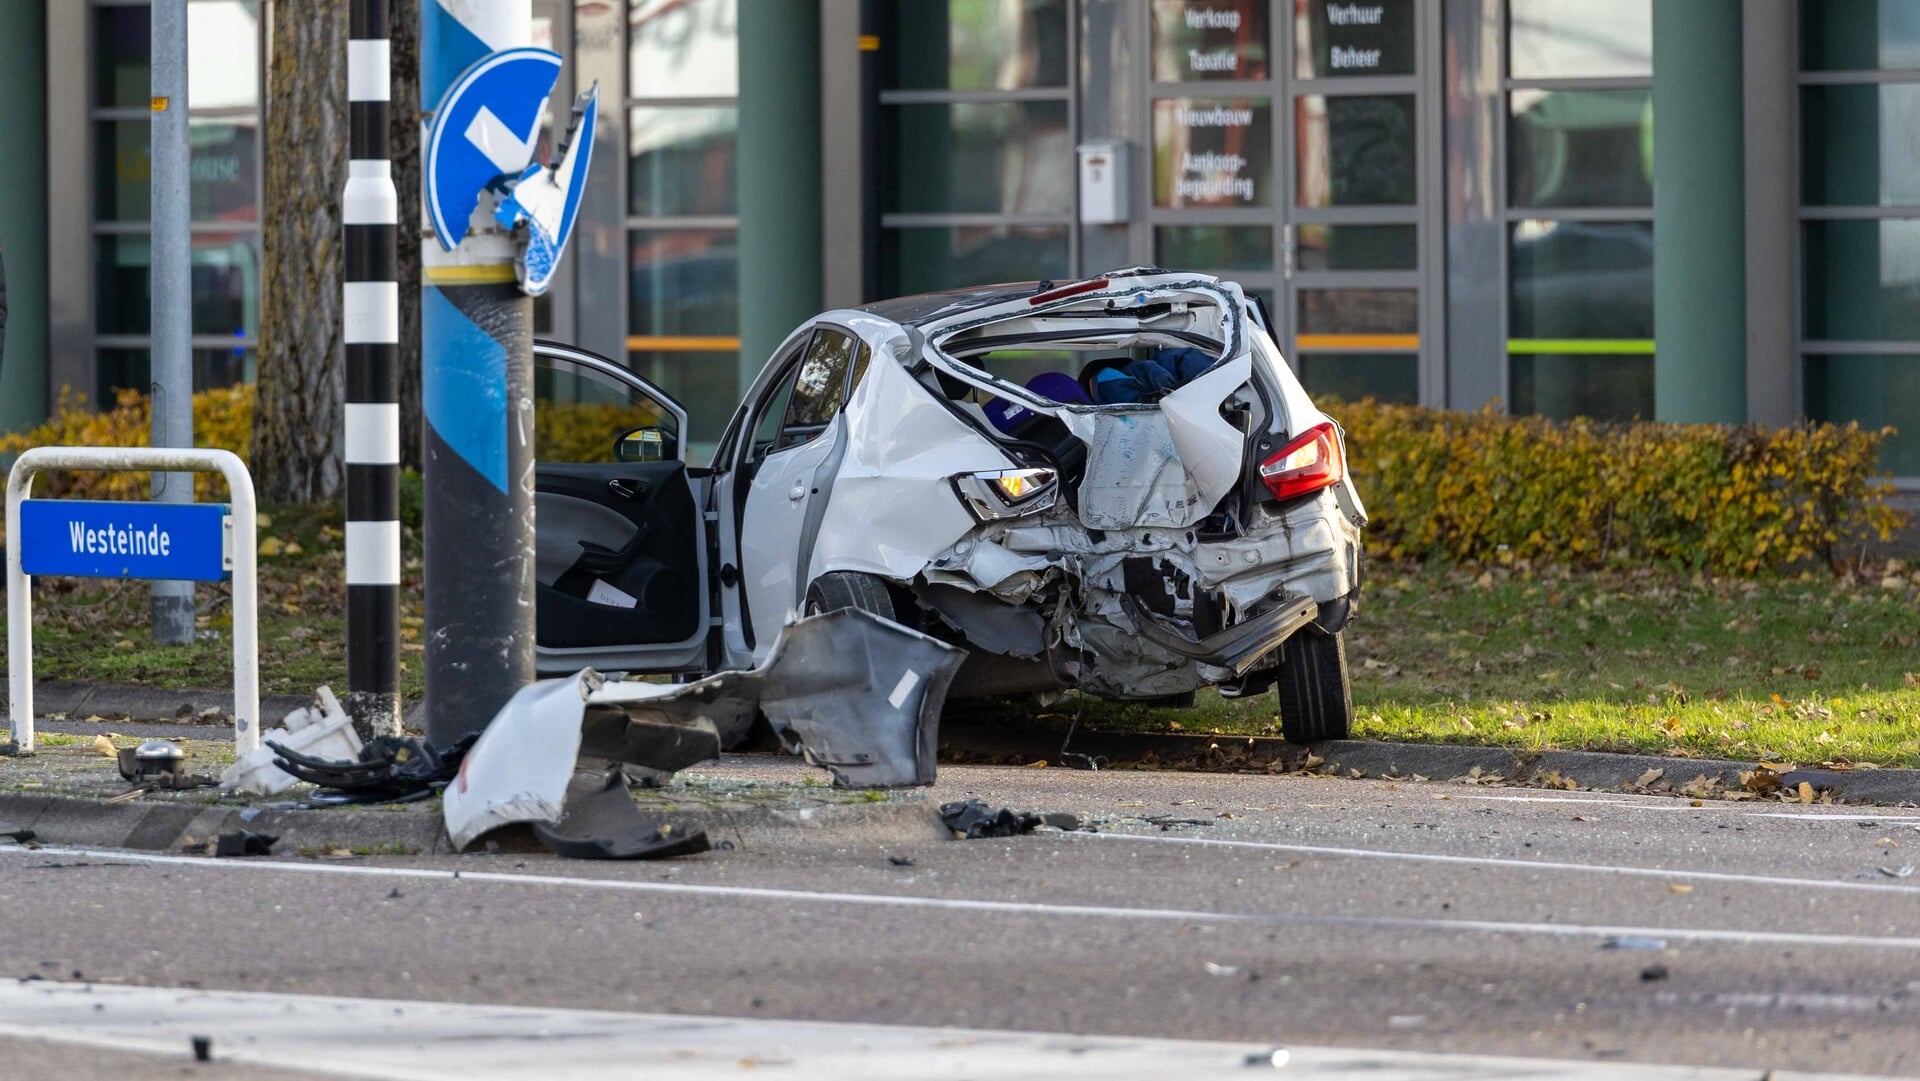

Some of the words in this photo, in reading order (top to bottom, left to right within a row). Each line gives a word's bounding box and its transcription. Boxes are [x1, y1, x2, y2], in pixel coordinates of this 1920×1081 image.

[1185, 8, 1241, 31] Verkoop
[1327, 4, 1383, 24] Verhuur
[1189, 49, 1238, 70] Taxatie
[1331, 46, 1380, 68] Beheer
[1175, 106, 1252, 126] Nieuwbouw
[1182, 152, 1247, 173] Aankoop-
[1176, 177, 1253, 200] begeleiding
[69, 520, 170, 557] Westeinde
